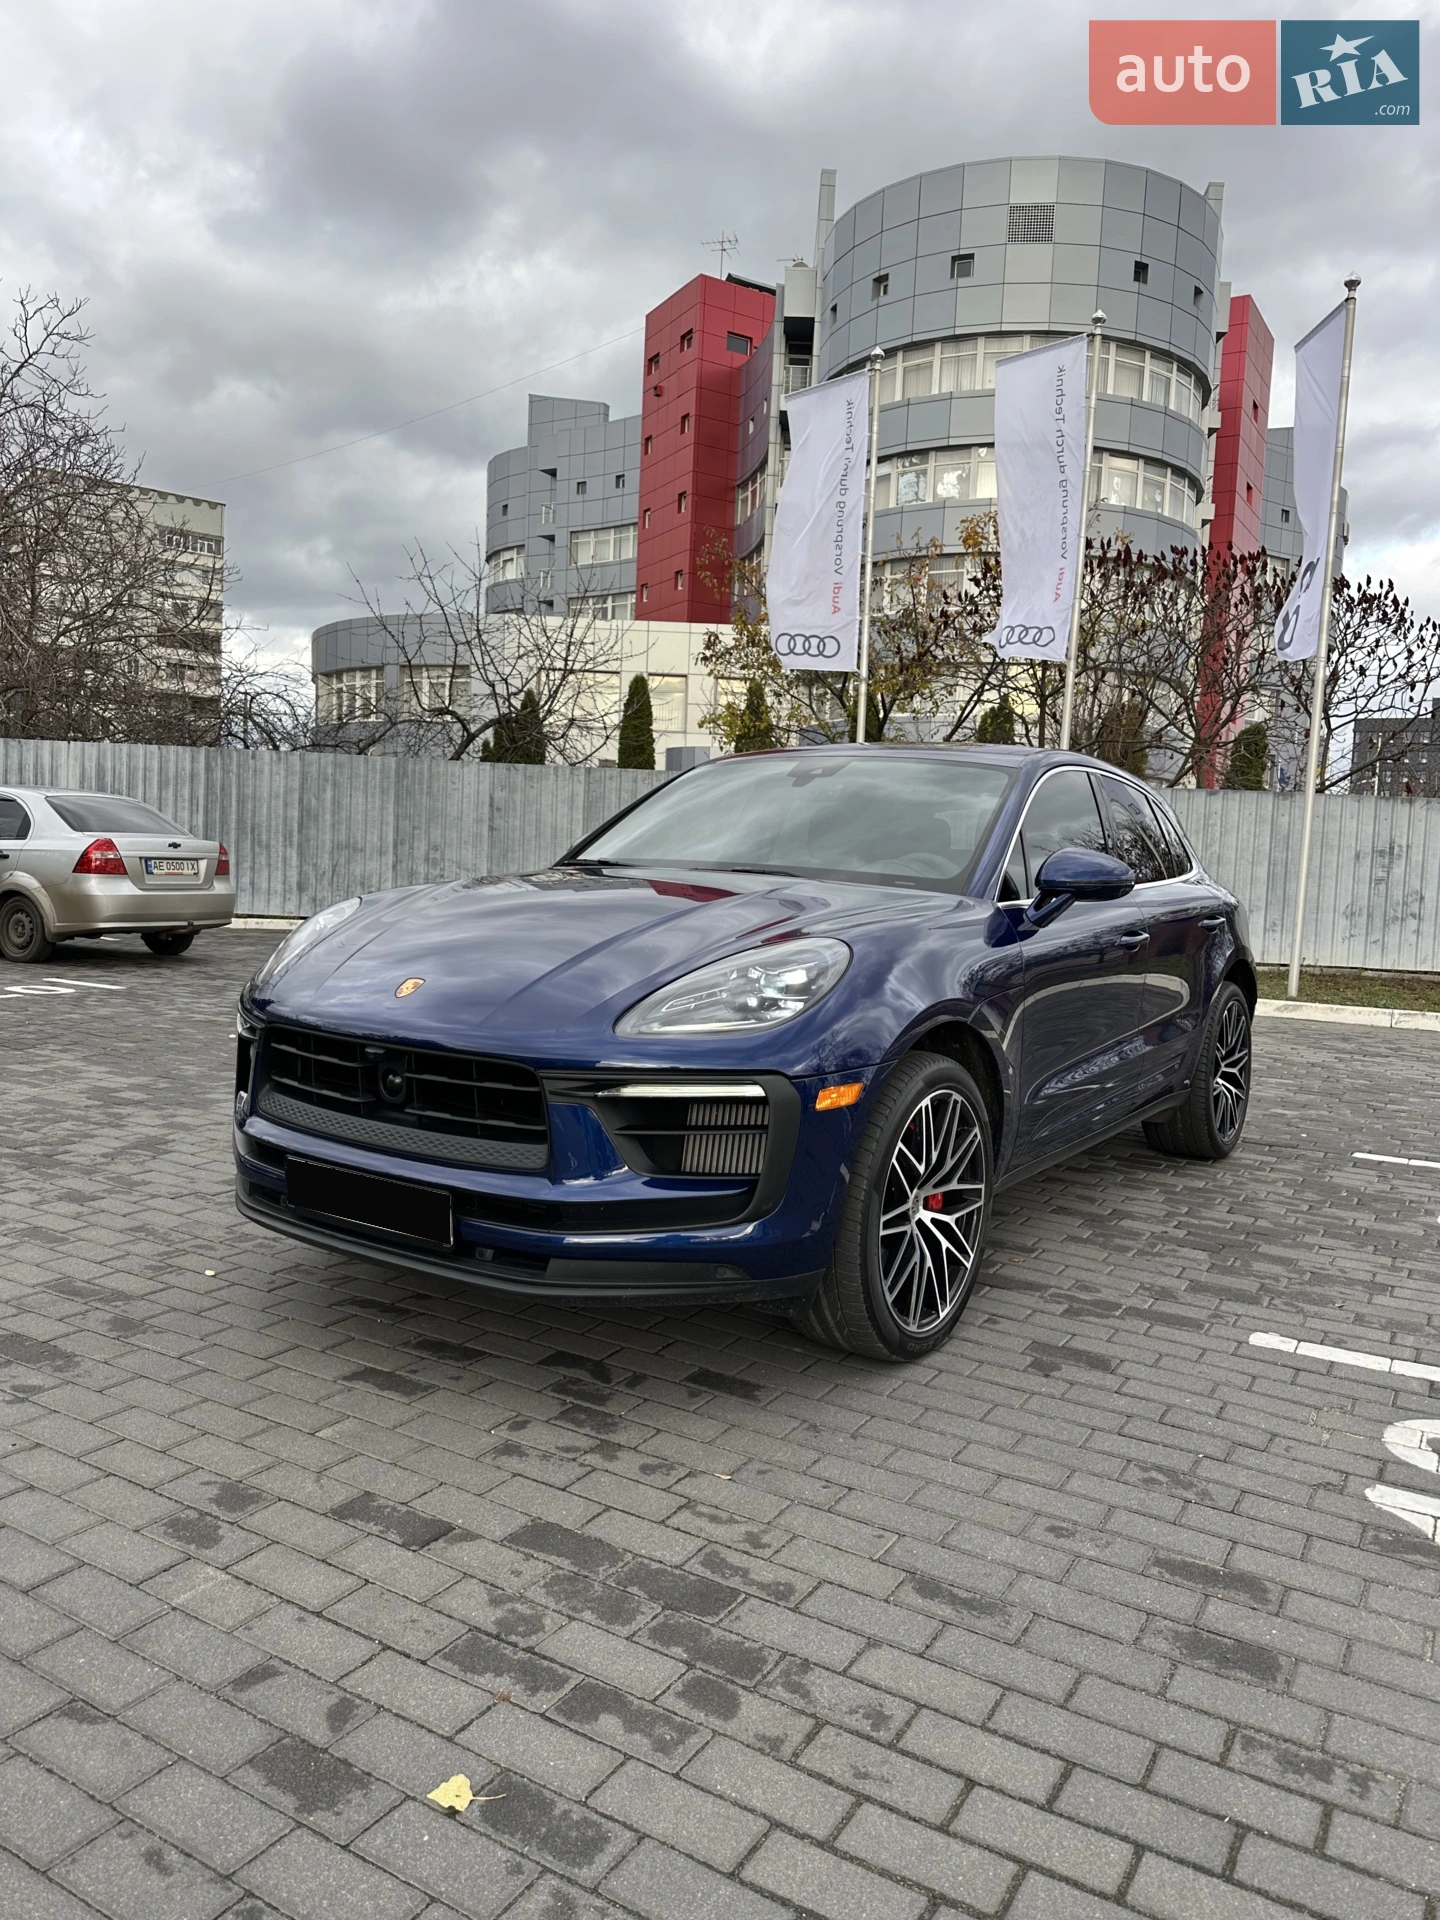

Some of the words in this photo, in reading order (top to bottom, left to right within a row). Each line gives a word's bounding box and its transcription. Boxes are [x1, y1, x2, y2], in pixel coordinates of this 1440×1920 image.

[153, 861, 164, 871] AE
[166, 861, 185, 871] 0500
[186, 862, 196, 871] IX
